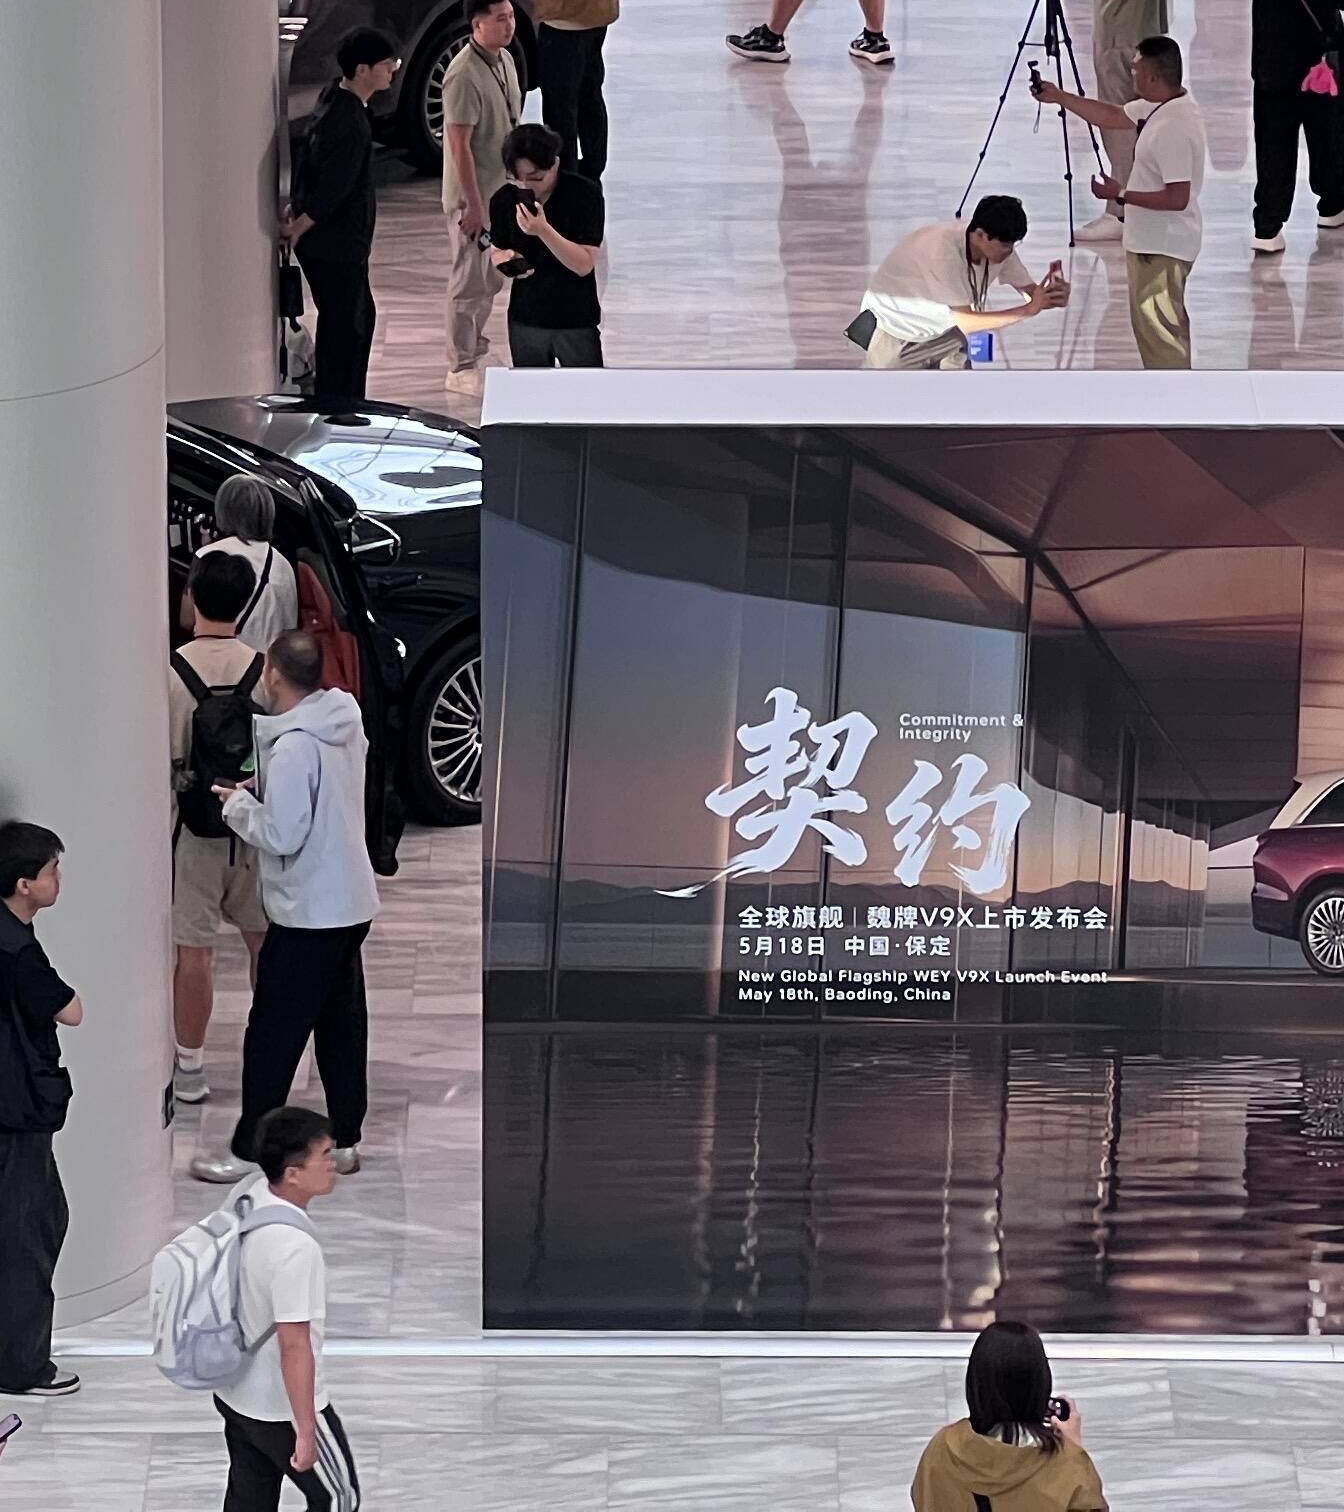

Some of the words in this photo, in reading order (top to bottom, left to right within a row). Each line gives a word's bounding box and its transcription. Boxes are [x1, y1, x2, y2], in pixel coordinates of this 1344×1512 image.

[899, 713, 1006, 727] Commitment
[1012, 713, 1024, 727] &
[899, 727, 972, 743] Integrity
[738, 905, 844, 929] 全球旗舰
[867, 905, 1108, 930] 魏牌V9X上市发布会
[738, 936, 826, 956] 5月18日
[844, 935, 951, 956] 中国·保定
[738, 969, 775, 983] New
[780, 969, 833, 983] Global
[838, 969, 908, 986] Flagship
[913, 970, 951, 983] WEY
[956, 970, 990, 983] V9X
[995, 970, 1055, 984] Launch
[1061, 970, 1108, 984] Event
[738, 988, 773, 1004] May
[779, 988, 819, 1003] 18th,
[824, 988, 898, 1004] Baoding,
[903, 988, 951, 1001] China
